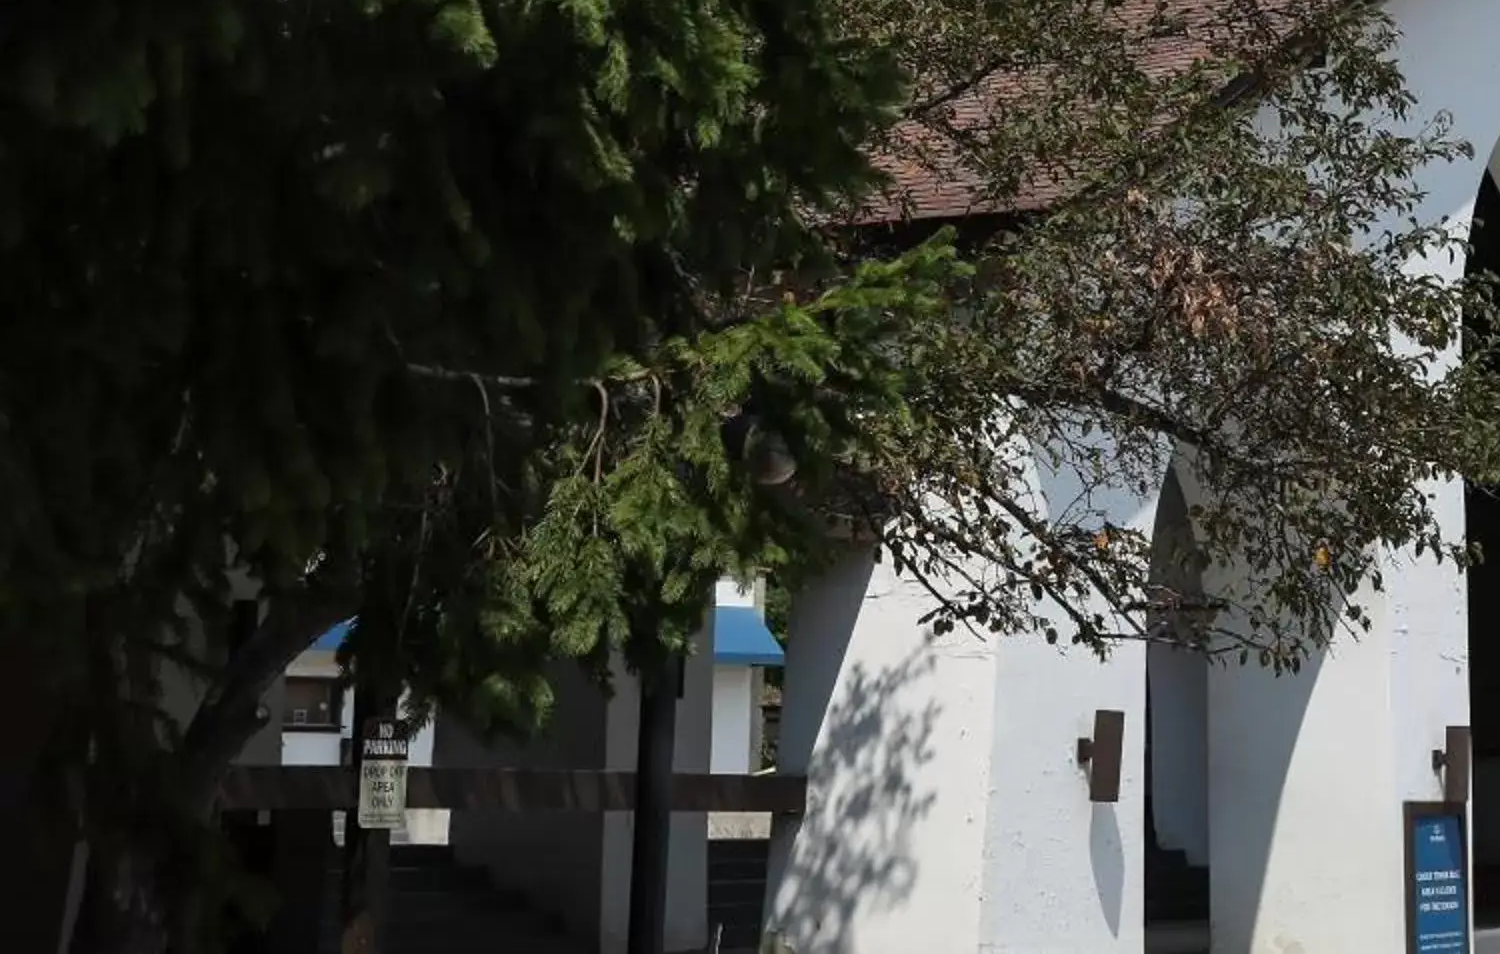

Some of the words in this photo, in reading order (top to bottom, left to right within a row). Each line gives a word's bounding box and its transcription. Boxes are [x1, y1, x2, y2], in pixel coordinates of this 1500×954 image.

[380, 723, 393, 738] NO
[364, 739, 406, 754] PARKING
[364, 766, 386, 778] DROP
[372, 781, 394, 792] AREA
[372, 797, 393, 808] ONLY
